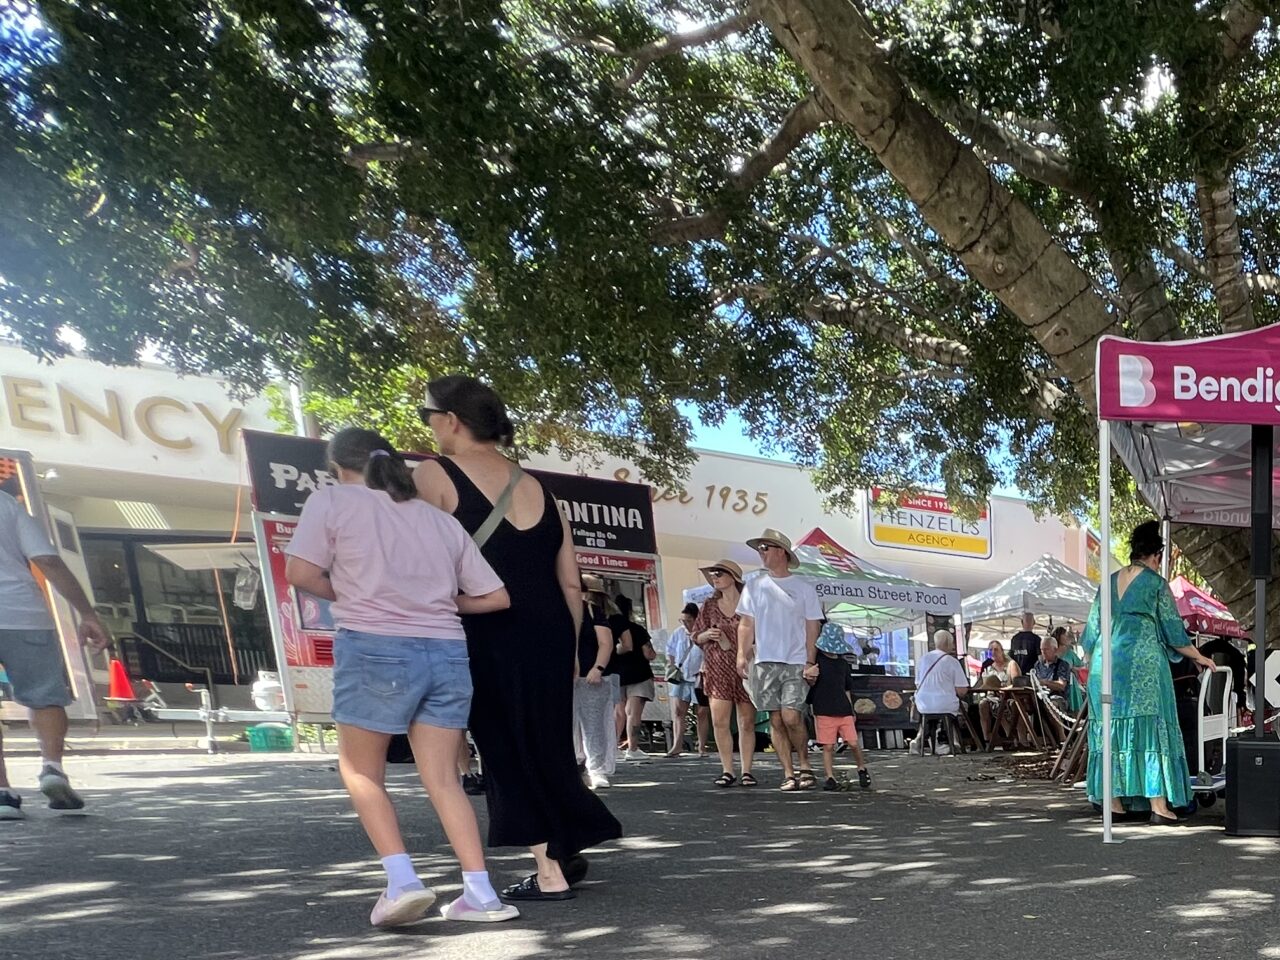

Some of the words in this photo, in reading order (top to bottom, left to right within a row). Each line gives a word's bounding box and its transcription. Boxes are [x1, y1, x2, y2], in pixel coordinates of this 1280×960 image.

[2, 375, 243, 455] ENCY
[706, 484, 768, 514] 1935
[908, 498, 932, 508] SINCE
[880, 510, 980, 536] HENZELLS
[573, 528, 596, 538] Follow
[597, 531, 606, 539] Us
[607, 532, 617, 540] On
[907, 533, 955, 547] AGENCY
[576, 553, 600, 565] Good
[602, 557, 628, 568] Times
[816, 583, 864, 599] garian
[868, 585, 913, 602] Street
[915, 591, 947, 606] Food
